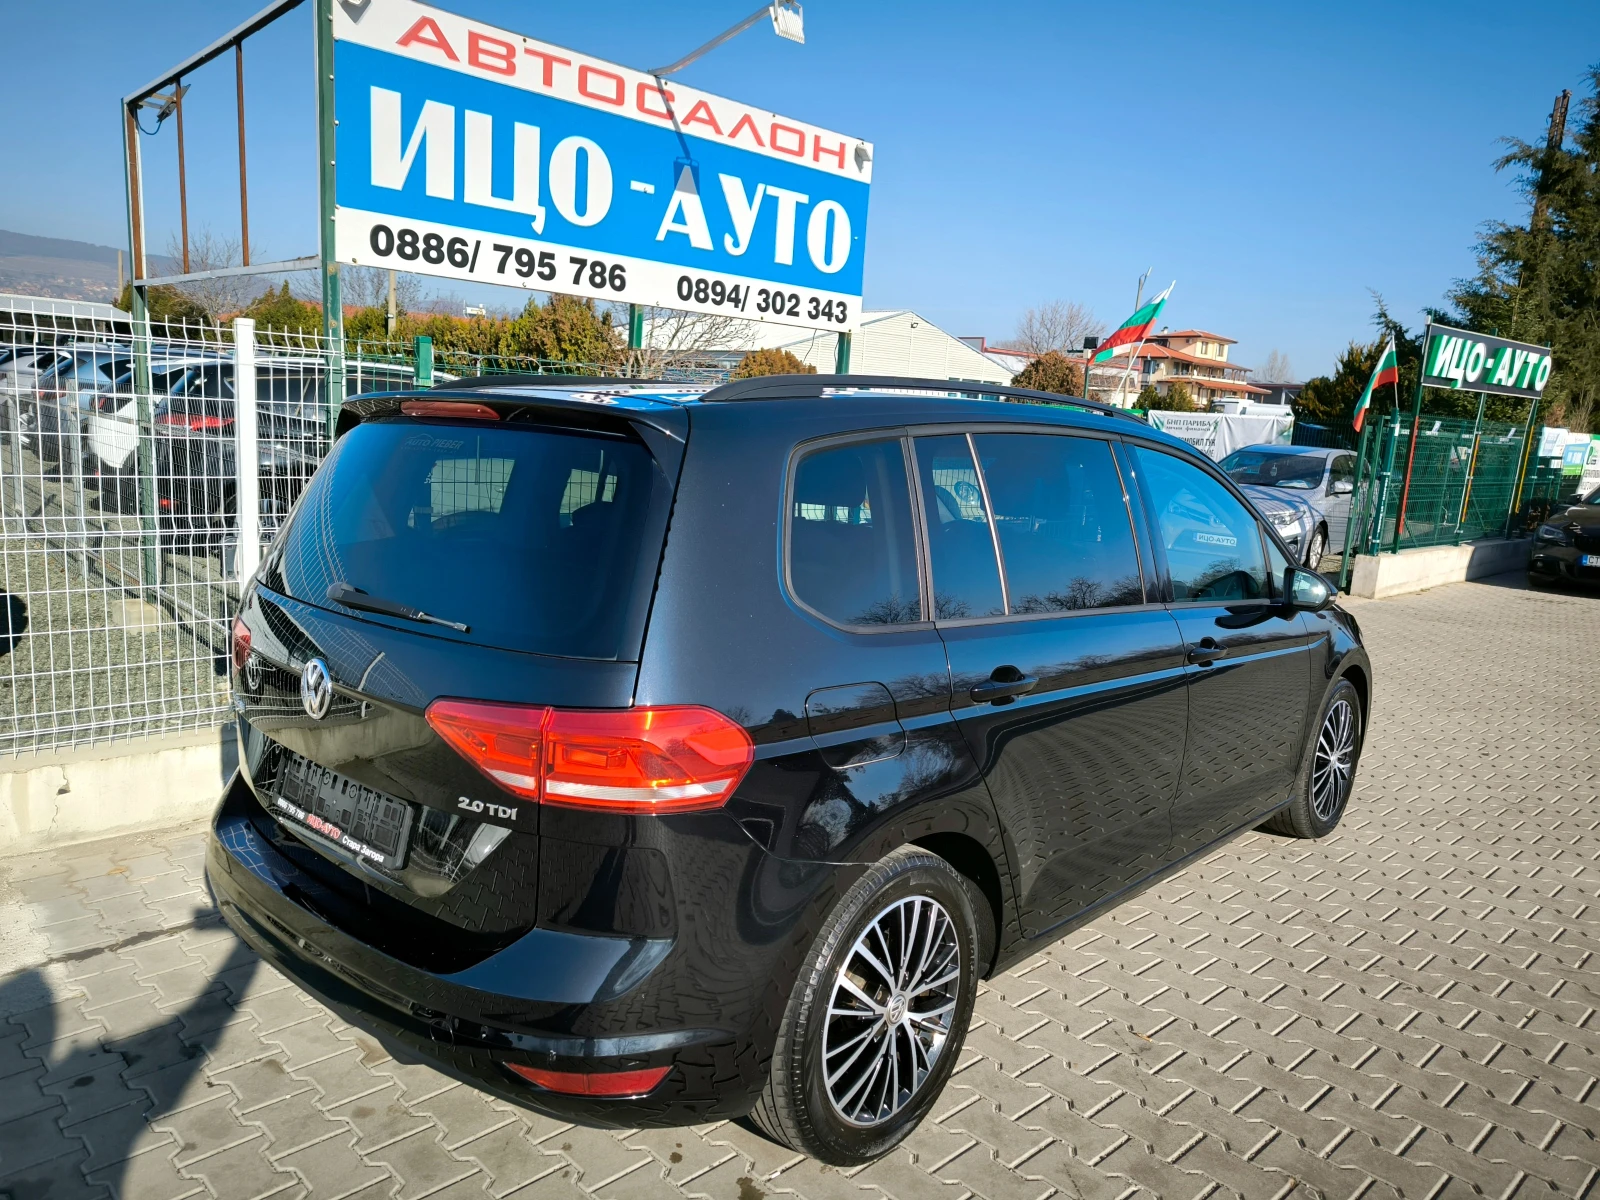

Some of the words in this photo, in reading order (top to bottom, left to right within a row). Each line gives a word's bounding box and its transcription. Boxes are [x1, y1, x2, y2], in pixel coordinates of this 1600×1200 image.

[396, 16, 847, 170] АВТОСАЛОН
[369, 223, 481, 273] 0886/
[493, 243, 557, 281] 795
[568, 256, 627, 292] 786
[676, 274, 750, 313] 0894/
[755, 288, 801, 319] 302
[807, 299, 848, 324] 343
[1432, 334, 1552, 390] ИЦО-АУТО
[1182, 419, 1211, 427] ПАРИБА
[486, 803, 518, 821] TDI
[342, 835, 361, 851] Стара
[360, 844, 385, 863] Загора
